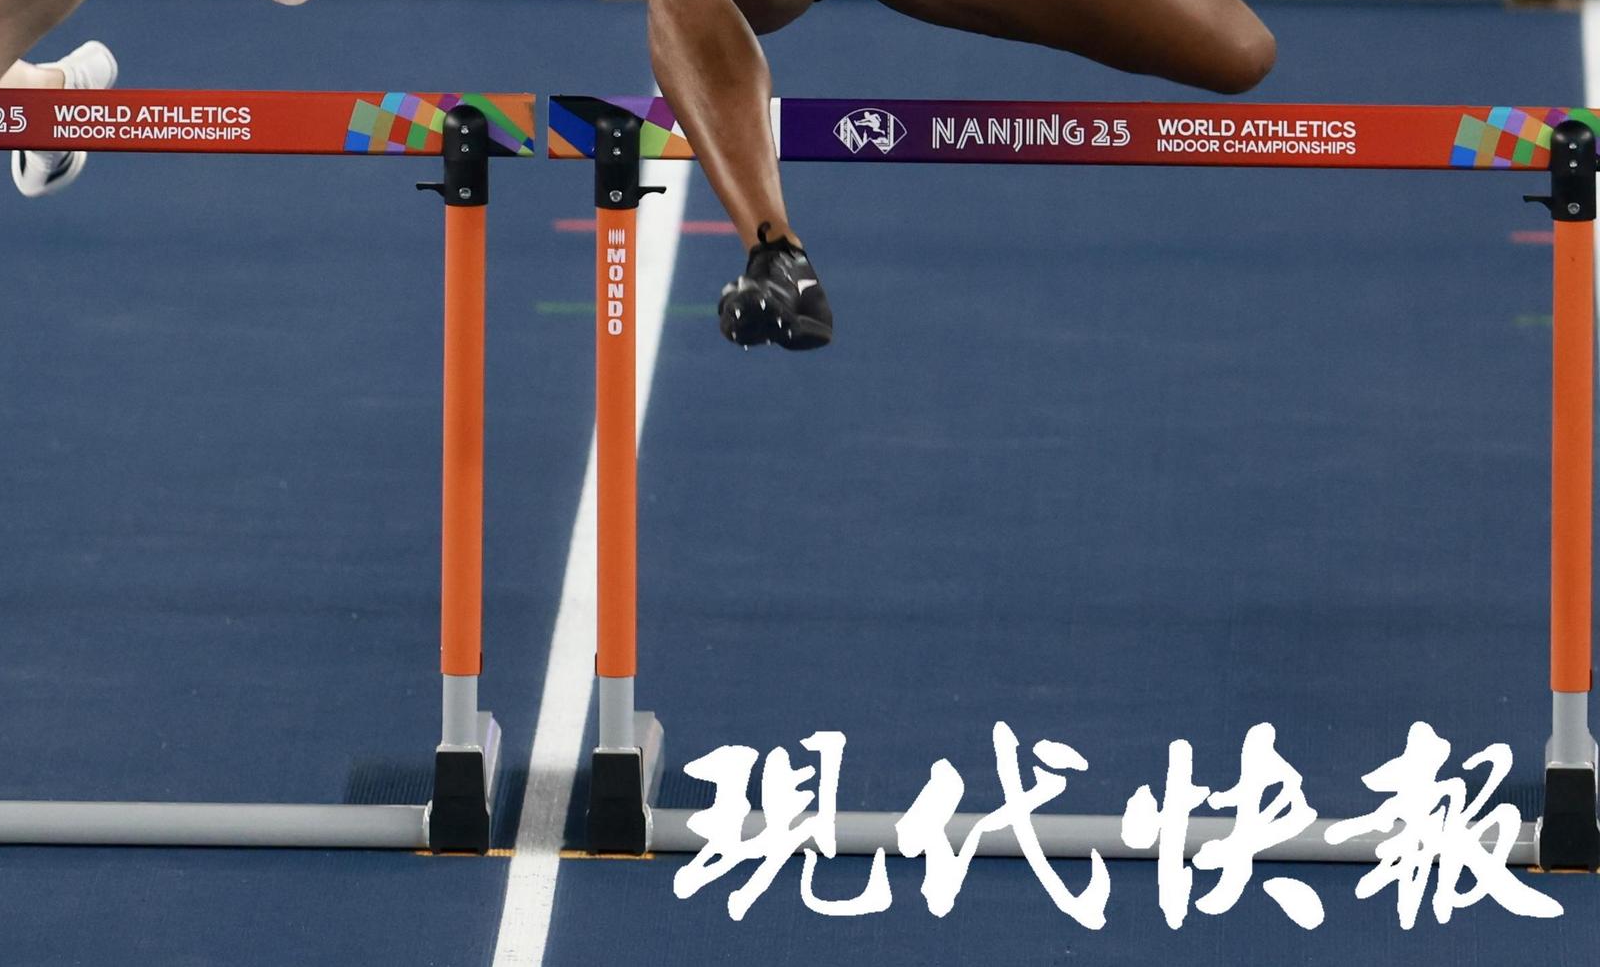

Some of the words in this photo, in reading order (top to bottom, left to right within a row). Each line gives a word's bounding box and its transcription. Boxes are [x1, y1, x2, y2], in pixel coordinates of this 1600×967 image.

[54, 105, 131, 123] WORLD
[136, 106, 251, 124] ATHLETICS
[53, 125, 116, 139] INDOOR
[119, 126, 251, 140] CHAMPIONSHIPS
[932, 114, 1085, 153] NANJING
[1091, 119, 1131, 146] 25
[1157, 118, 1235, 136] WORLD
[1240, 120, 1356, 138] ATHLETICS
[1157, 139, 1220, 152] INDOOR
[1223, 140, 1356, 155] CHAMPIONSHIPS
[607, 248, 626, 336] MONDO
